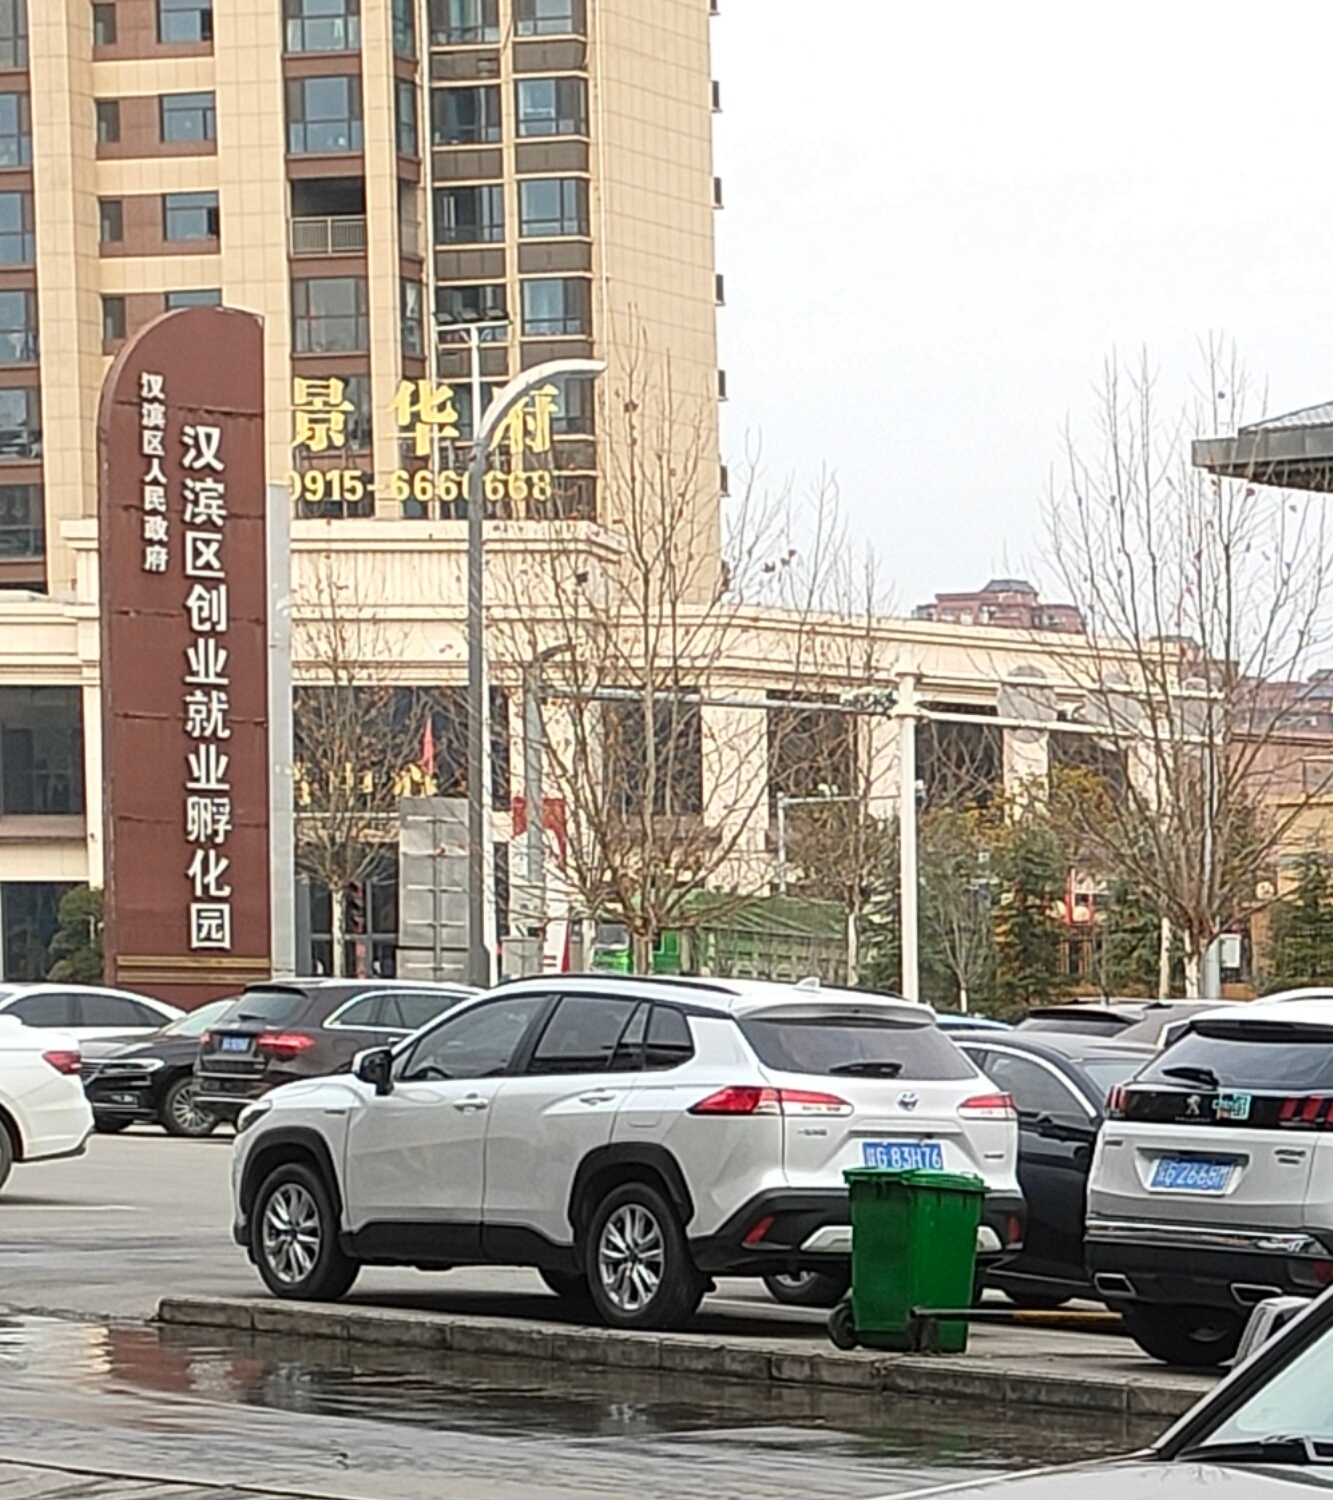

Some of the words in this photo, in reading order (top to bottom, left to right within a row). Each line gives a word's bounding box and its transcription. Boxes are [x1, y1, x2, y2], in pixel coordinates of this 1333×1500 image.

[140, 371, 169, 572] 汉滨区人民政府
[181, 424, 233, 950] 汉滨区创业就业孵化园
